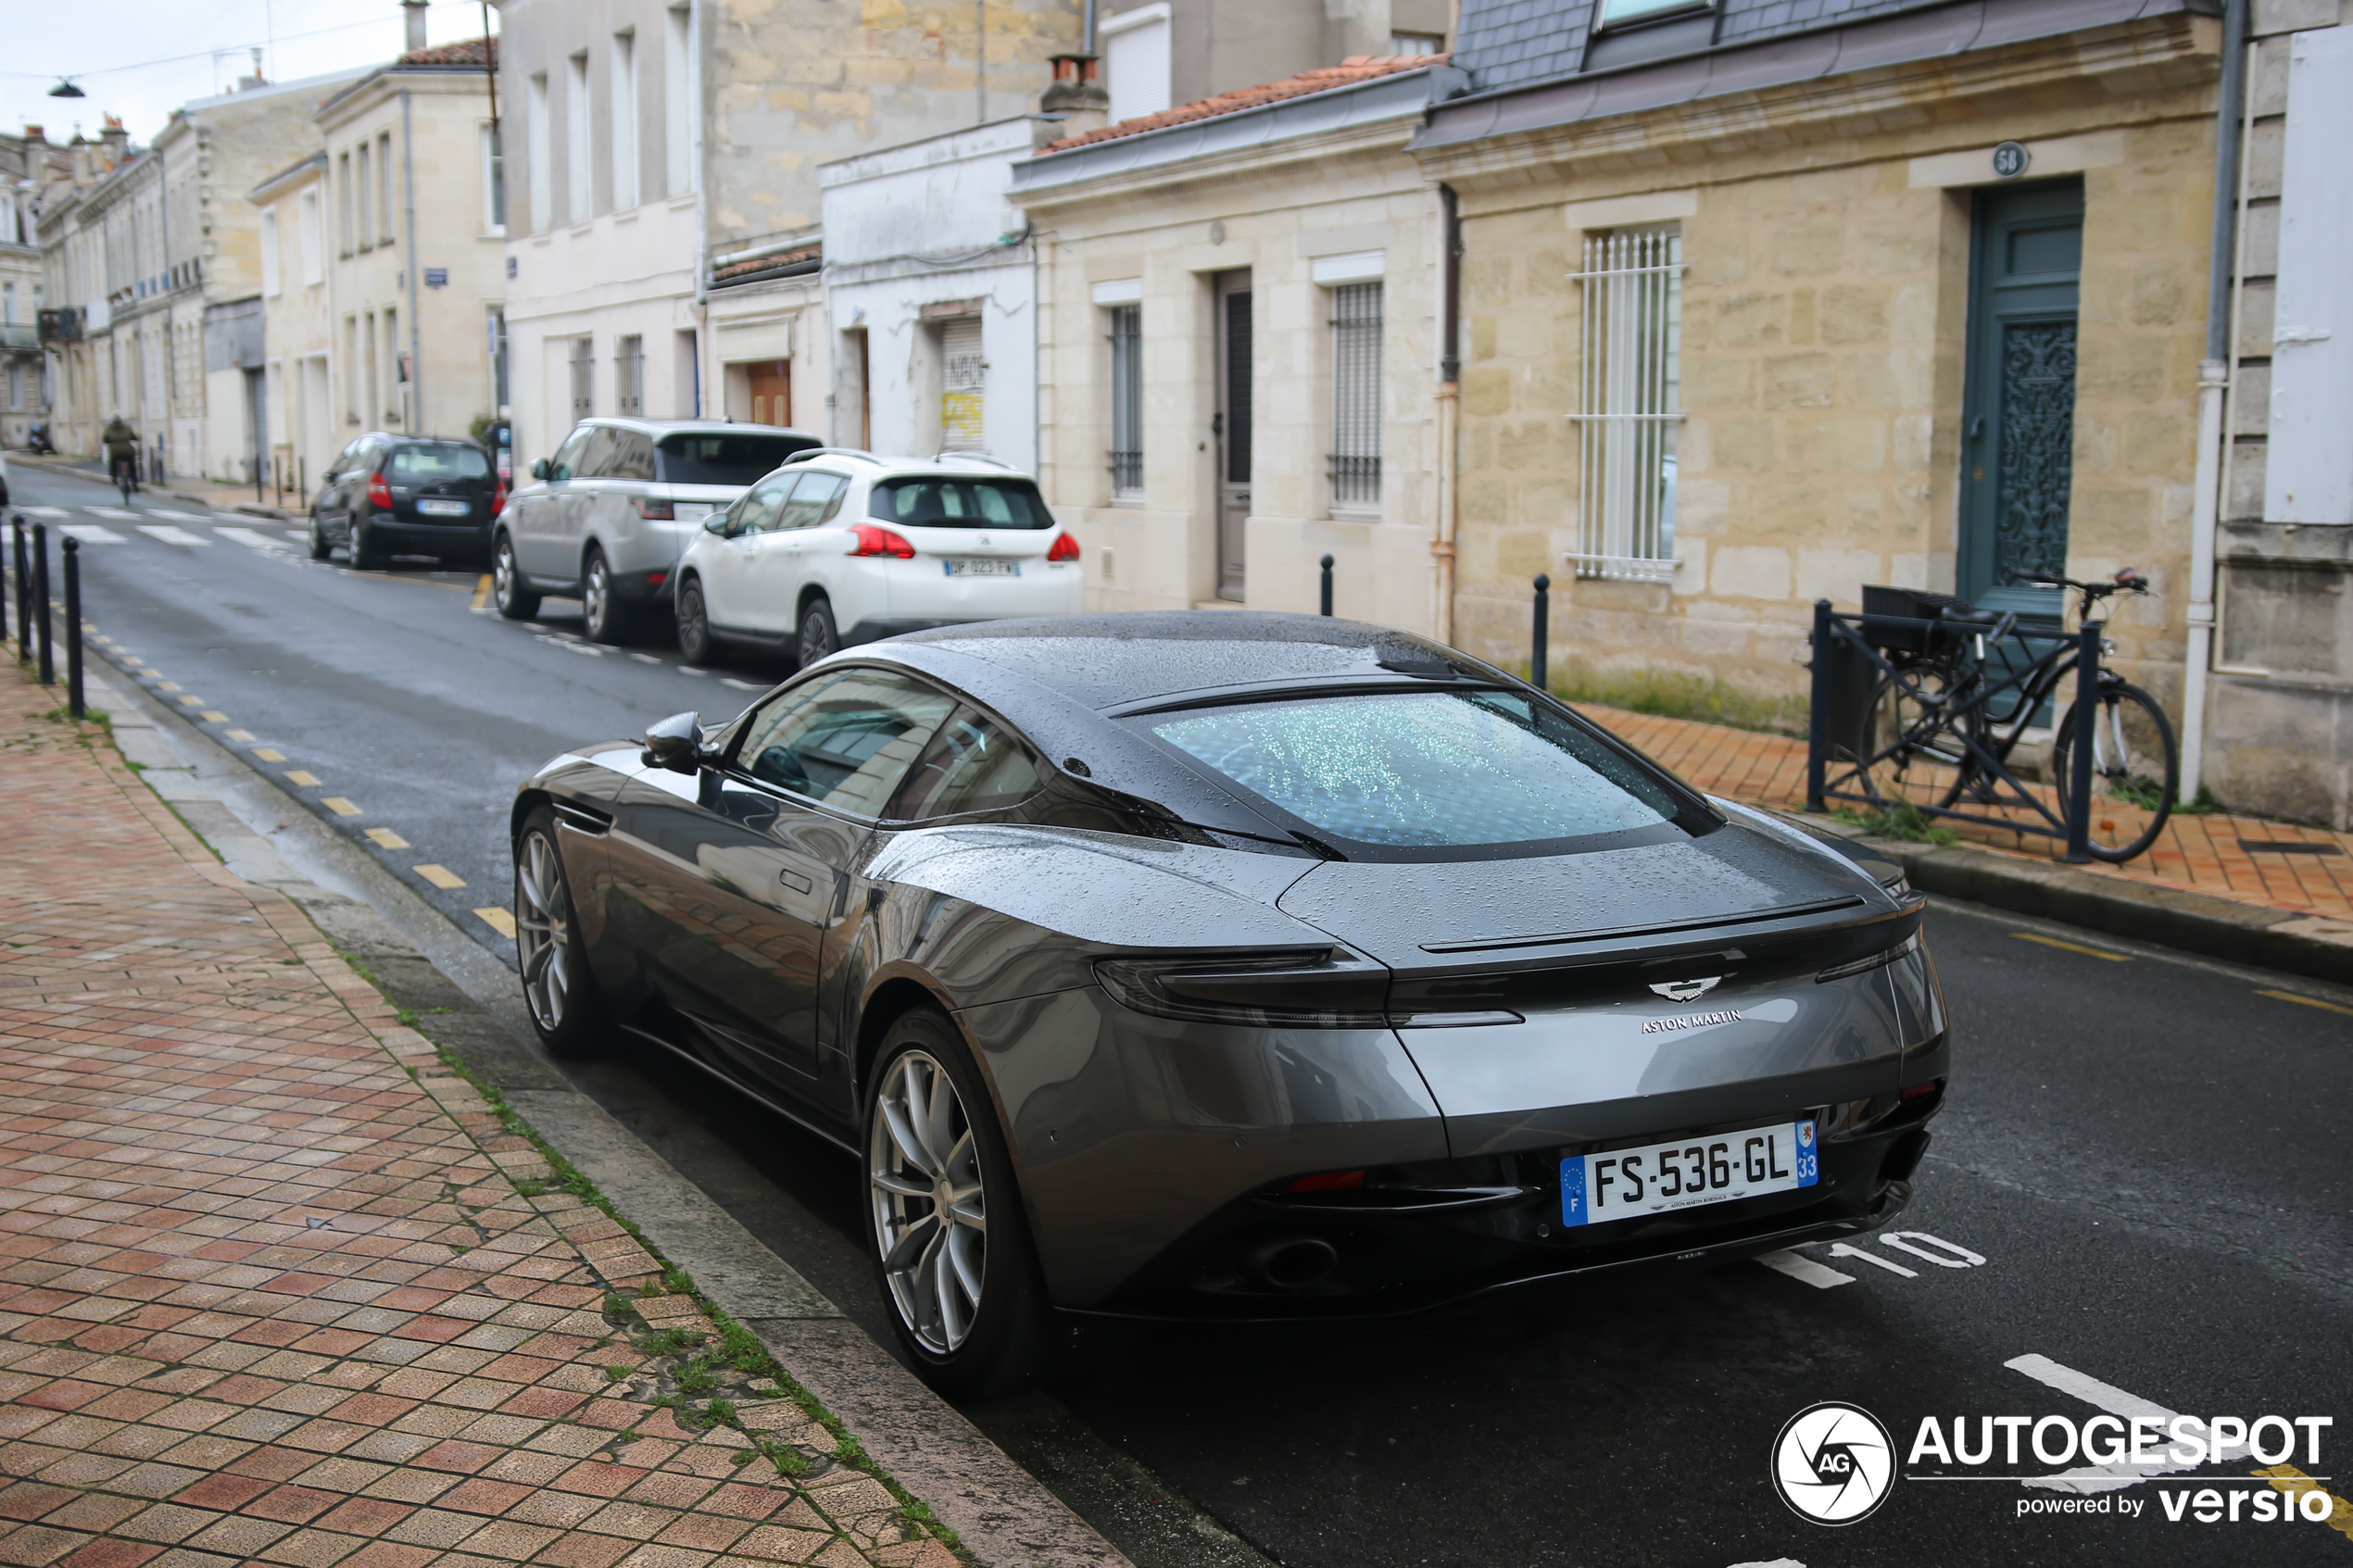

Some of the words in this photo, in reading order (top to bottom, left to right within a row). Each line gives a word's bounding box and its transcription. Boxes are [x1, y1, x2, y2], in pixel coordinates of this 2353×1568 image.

[1998, 149, 2018, 172] 58
[1642, 1018, 1688, 1034] ASTON
[1691, 1009, 1742, 1028] MARTIN
[1798, 1154, 1818, 1179] 33
[1570, 1198, 1579, 1212] F
[1686, 1198, 1703, 1206] MARTIN
[1704, 1195, 1728, 1204] BORDEAUX
